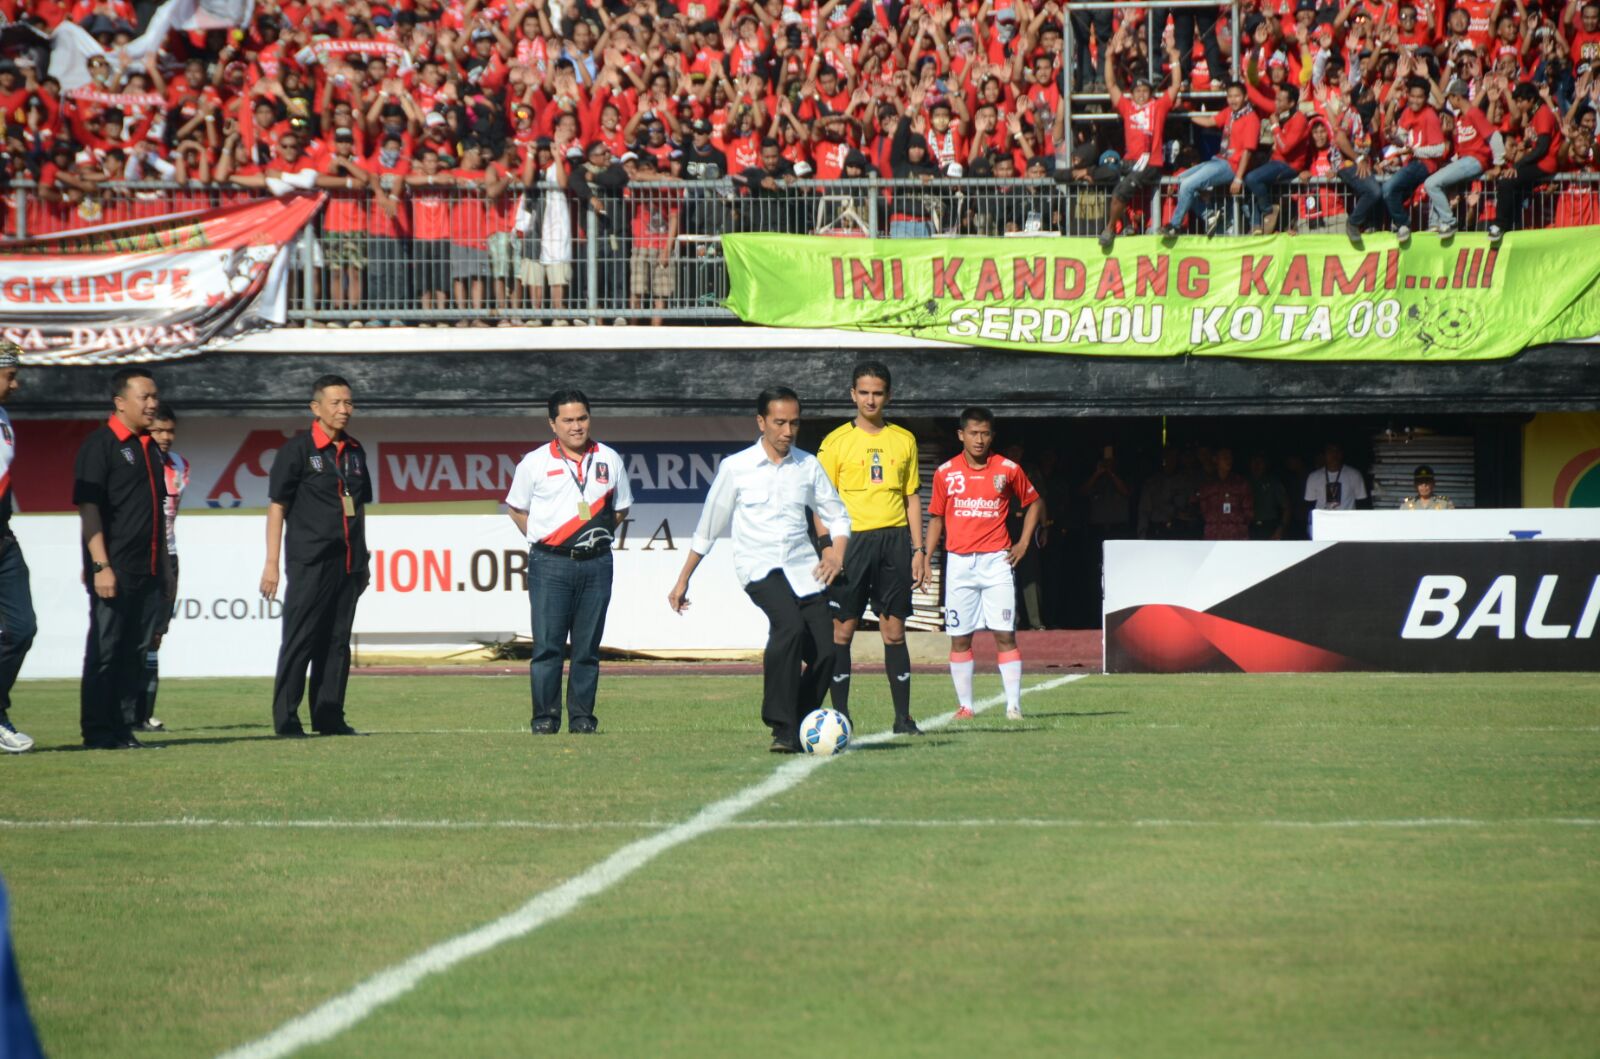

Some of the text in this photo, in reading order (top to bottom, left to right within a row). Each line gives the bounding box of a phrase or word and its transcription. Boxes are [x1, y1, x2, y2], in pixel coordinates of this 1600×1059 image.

[832, 257, 904, 300] INI
[932, 256, 1210, 300] KANDANG
[947, 300, 1401, 344] SERDADU KOTA 08
[619, 453, 722, 490] ARN
[945, 475, 965, 495] 23
[953, 509, 1000, 518] CORSA
[954, 497, 1000, 511] Indofood
[370, 548, 528, 592] ION.OR
[1401, 574, 1600, 639] BALI
